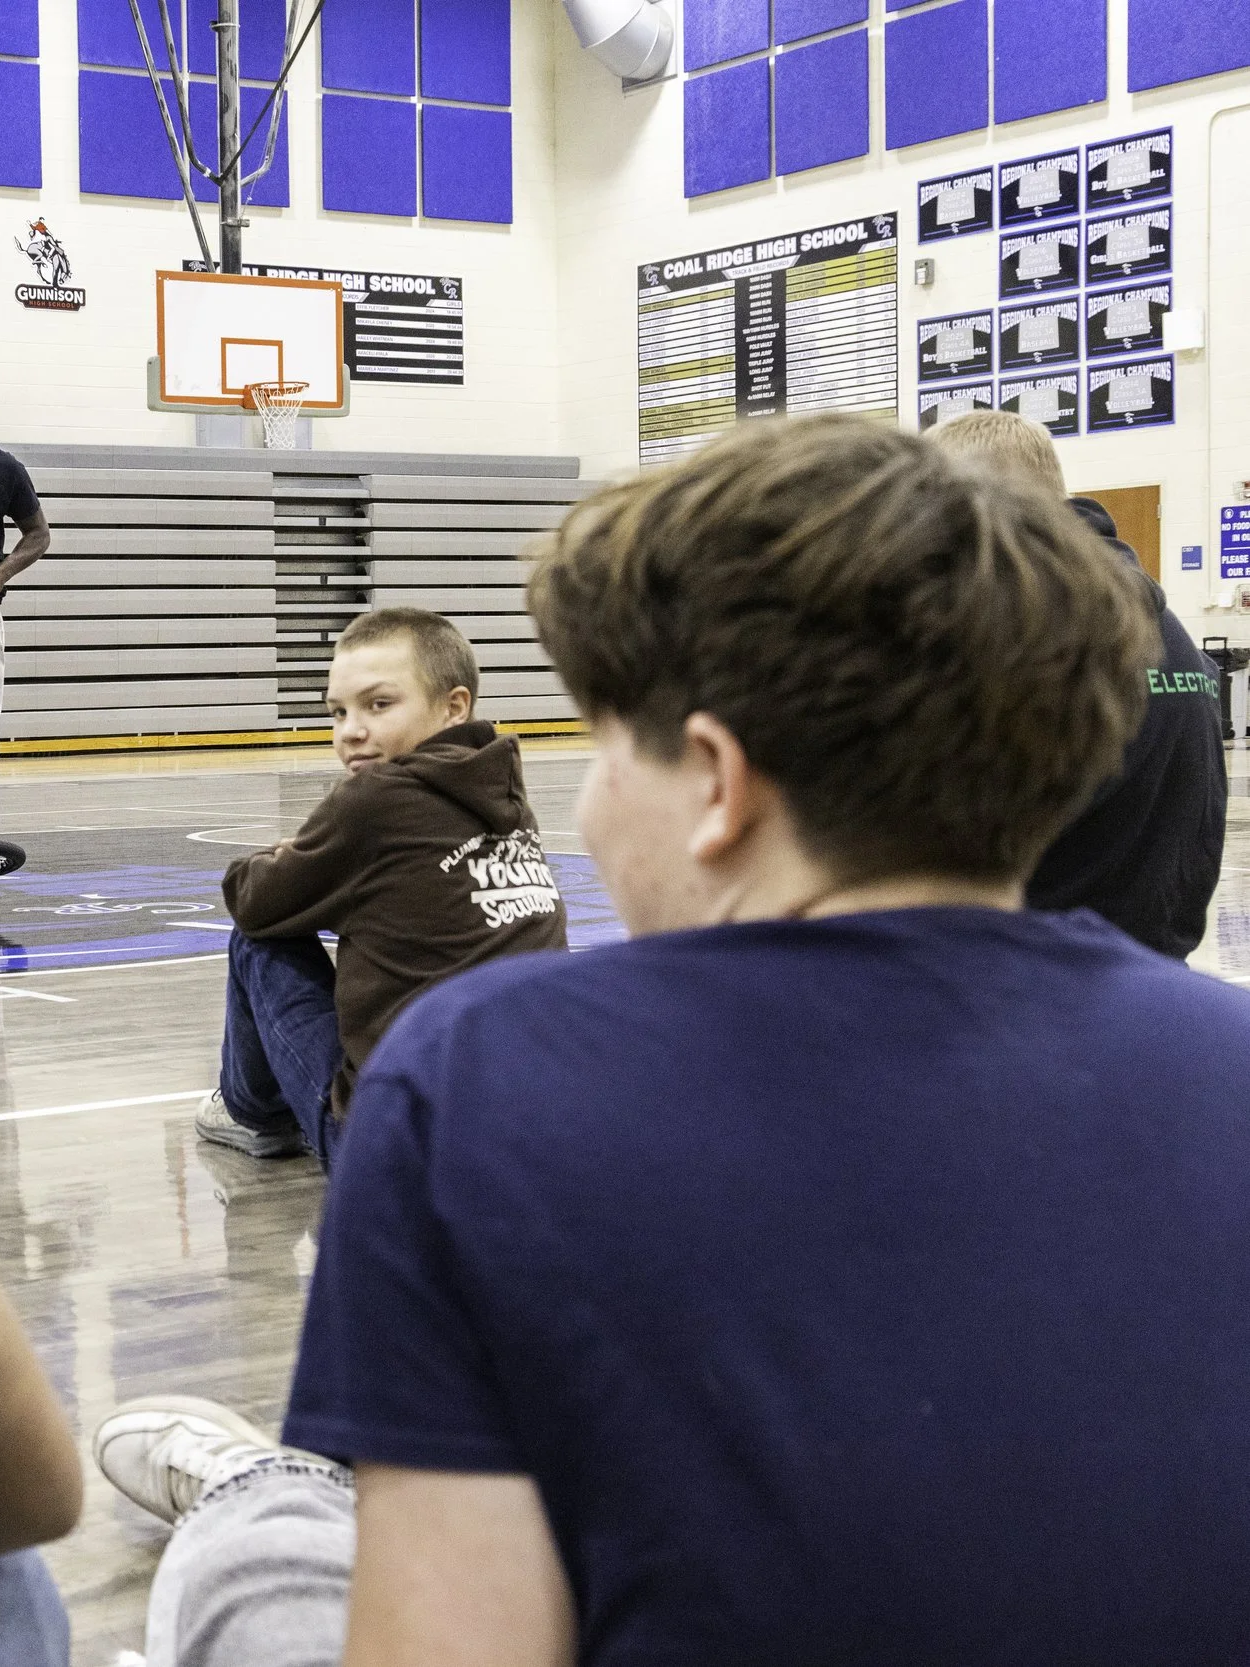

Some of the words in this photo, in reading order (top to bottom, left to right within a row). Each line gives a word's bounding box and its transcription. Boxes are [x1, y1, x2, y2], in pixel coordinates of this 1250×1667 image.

[1088, 144, 1125, 172] REGIONAL
[1125, 134, 1170, 155] CHAMPIONS
[1001, 162, 1036, 189] REGIONAL
[1036, 153, 1078, 174] CHAMPIONS
[1088, 218, 1125, 245] REGIONAL
[1125, 209, 1170, 230] CHAMPIONS
[663, 258, 704, 280] COAL
[707, 246, 753, 271] RIDGE
[756, 237, 797, 261] HIGH
[800, 222, 868, 252] SCHOOL
[1002, 234, 1037, 261] REGIONAL
[1036, 227, 1078, 248] CHAMPIONS
[323, 272, 366, 291] HIGH
[370, 275, 436, 295] SCHOOL
[1088, 292, 1125, 319] REGIONAL
[1124, 285, 1170, 306] CHAMPIONS
[920, 320, 952, 344] REGIONAL
[952, 314, 991, 334] CHAMPIONS
[1001, 308, 1036, 333] REGIONAL
[1036, 301, 1077, 322] CHAMPIONS
[944, 346, 988, 359] BASKETBALL
[753, 375, 769, 383] DISCUS
[1001, 380, 1036, 404] REGIONAL
[1035, 375, 1077, 395] CHAMPIONS
[1090, 367, 1127, 392] REGIONAL
[1126, 361, 1172, 382] CHAMPIONS
[920, 390, 952, 414] REGIONAL
[952, 385, 992, 405] CHAMPIONS
[1105, 397, 1155, 411] VOLLEYBALL
[1222, 523, 1231, 531] NO
[1232, 534, 1240, 542] IN
[1222, 555, 1249, 564] PLEASE
[1227, 568, 1243, 577] OUR
